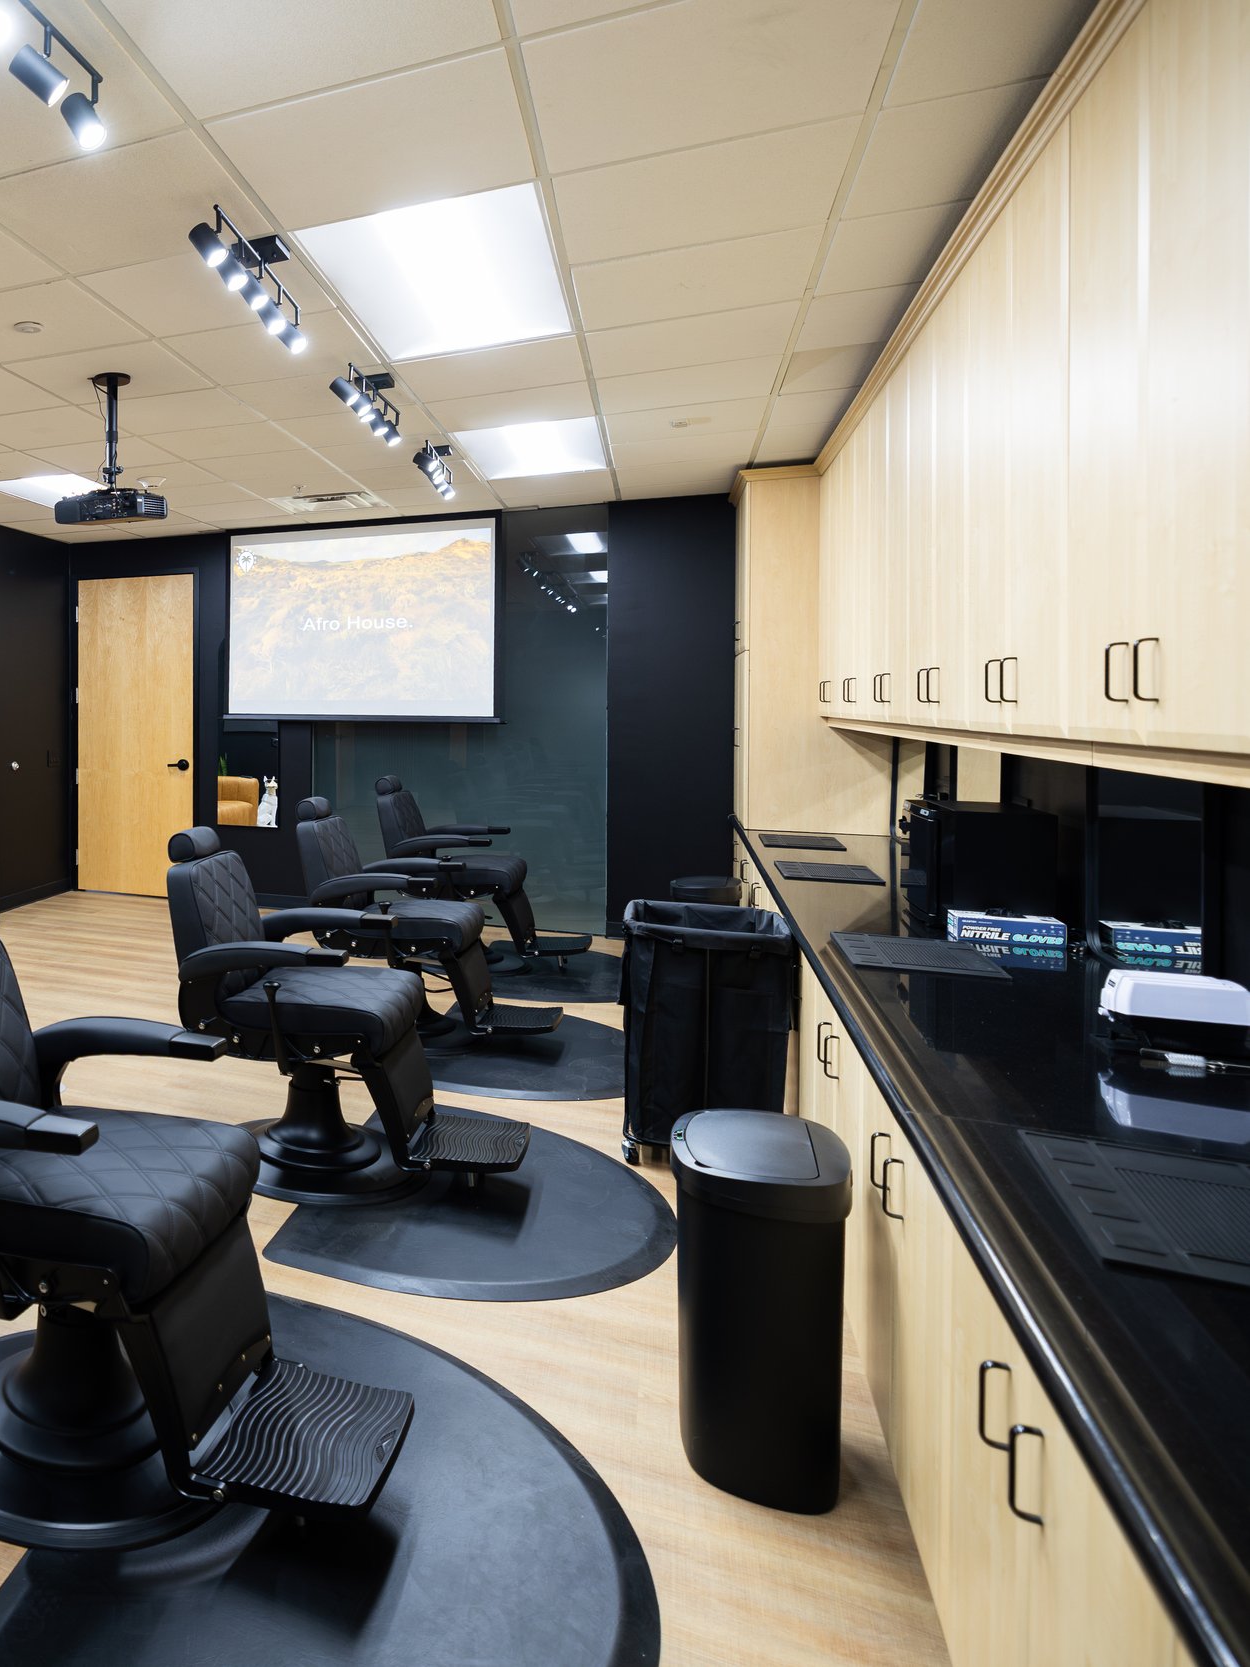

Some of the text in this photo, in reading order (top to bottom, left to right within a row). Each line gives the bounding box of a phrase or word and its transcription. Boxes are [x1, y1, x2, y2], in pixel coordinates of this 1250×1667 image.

[302, 616, 413, 631] Afro House.
[960, 930, 1064, 945] NITRILE GLOVES
